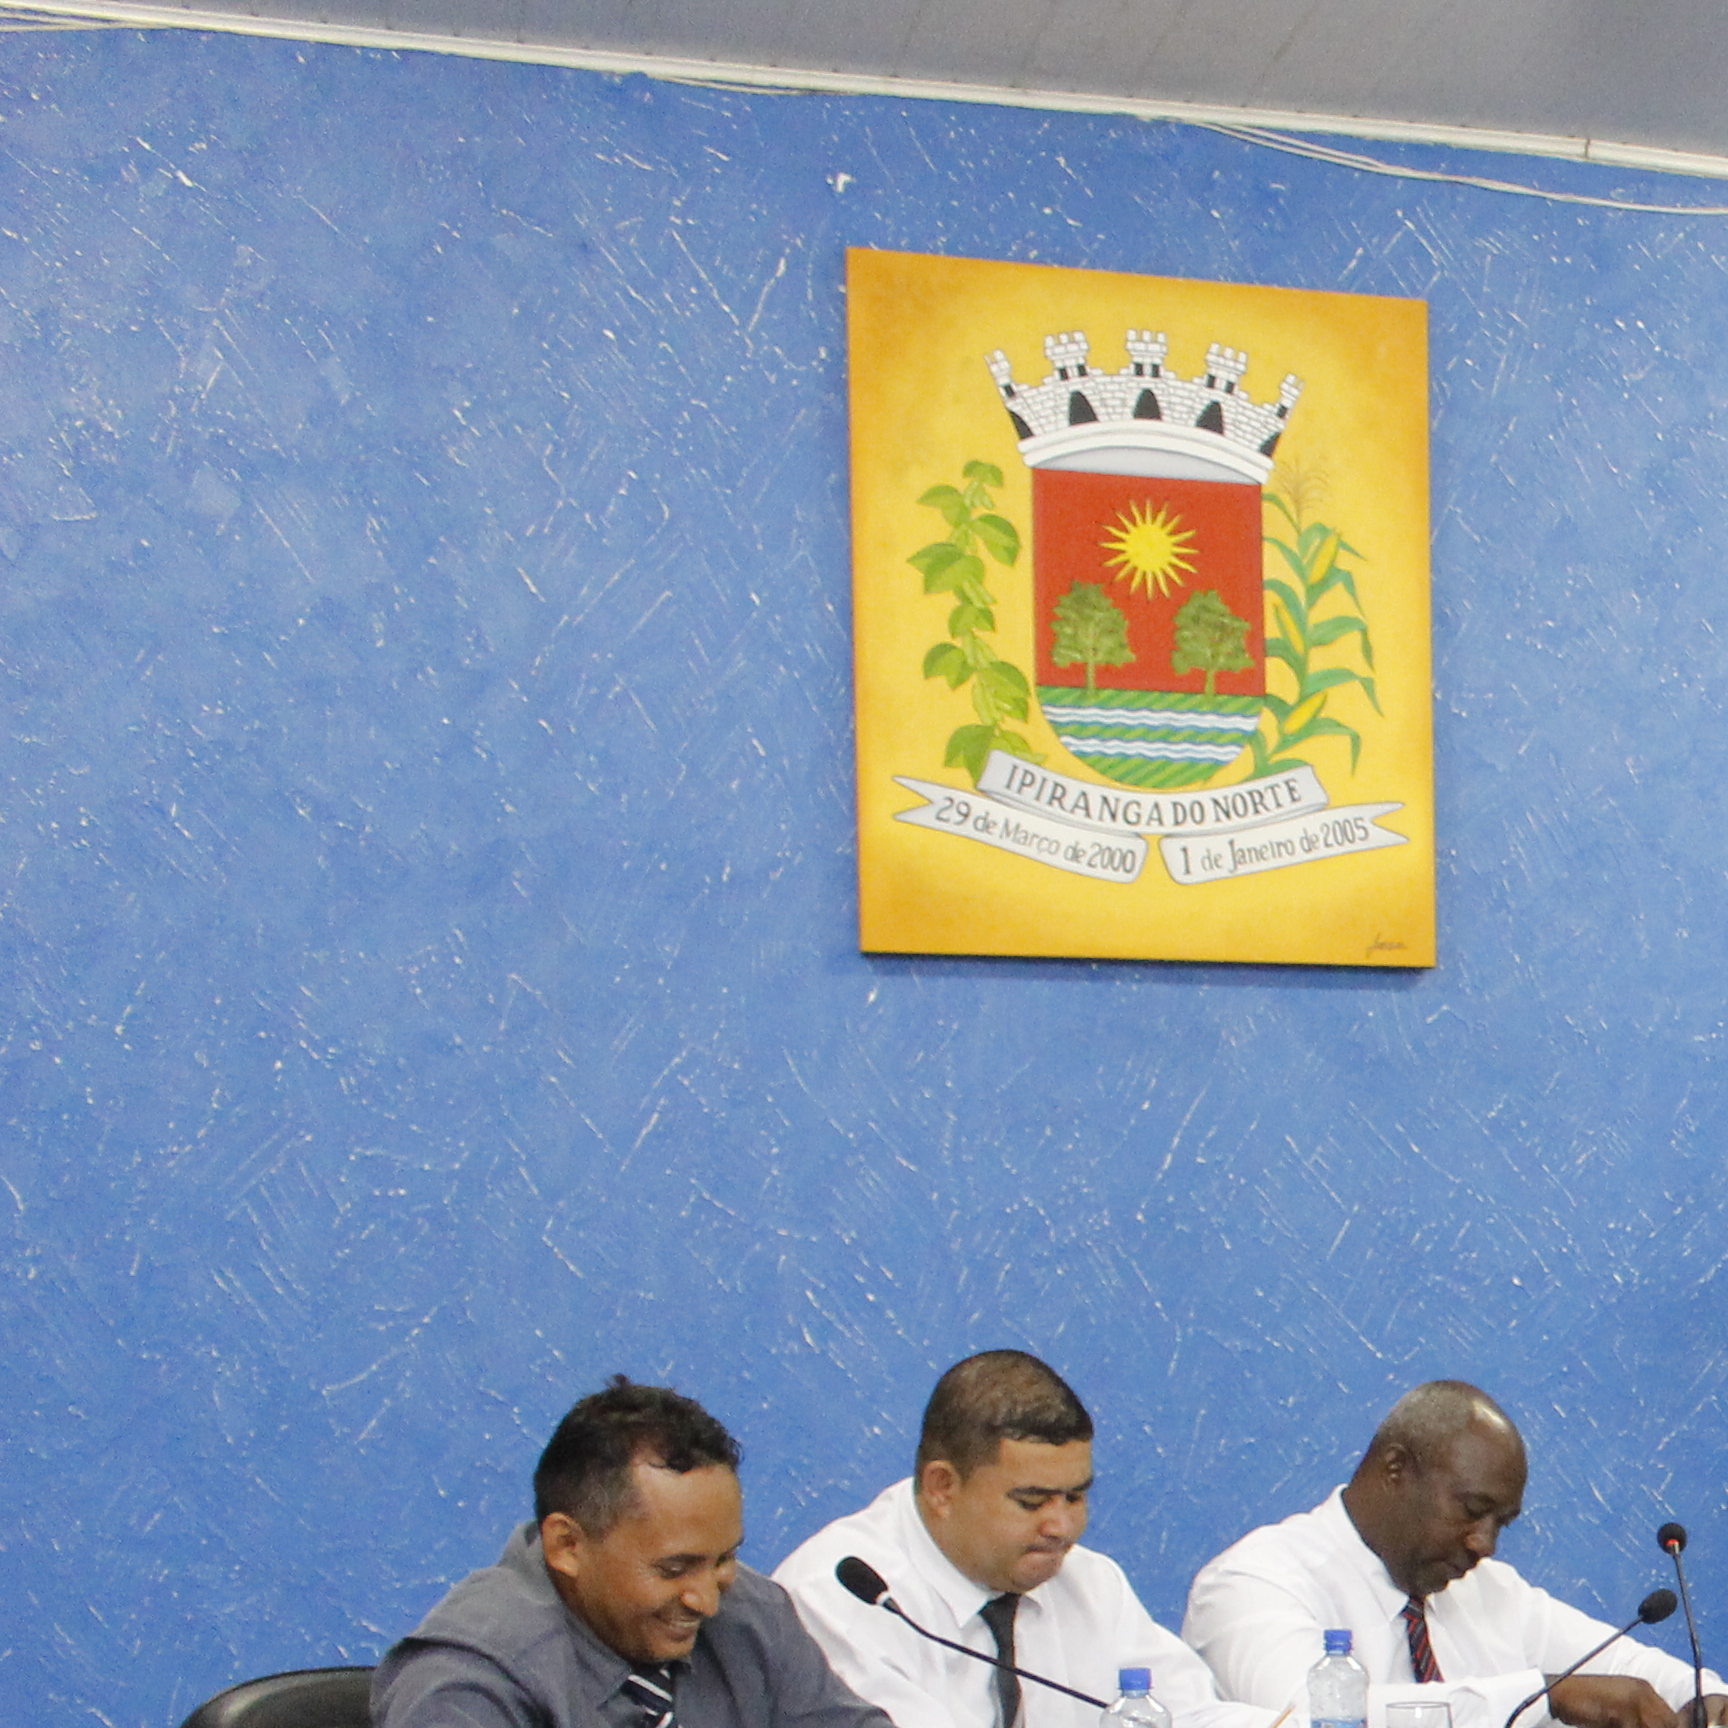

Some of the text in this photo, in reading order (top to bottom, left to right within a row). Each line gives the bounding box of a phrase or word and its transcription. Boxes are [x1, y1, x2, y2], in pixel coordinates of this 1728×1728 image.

[1005, 764, 1302, 827] IPIRANGA DO NORTE
[934, 797, 1136, 874] 29 de Março de 2000
[1180, 816, 1370, 875] 1 de Janeiro de 2005
